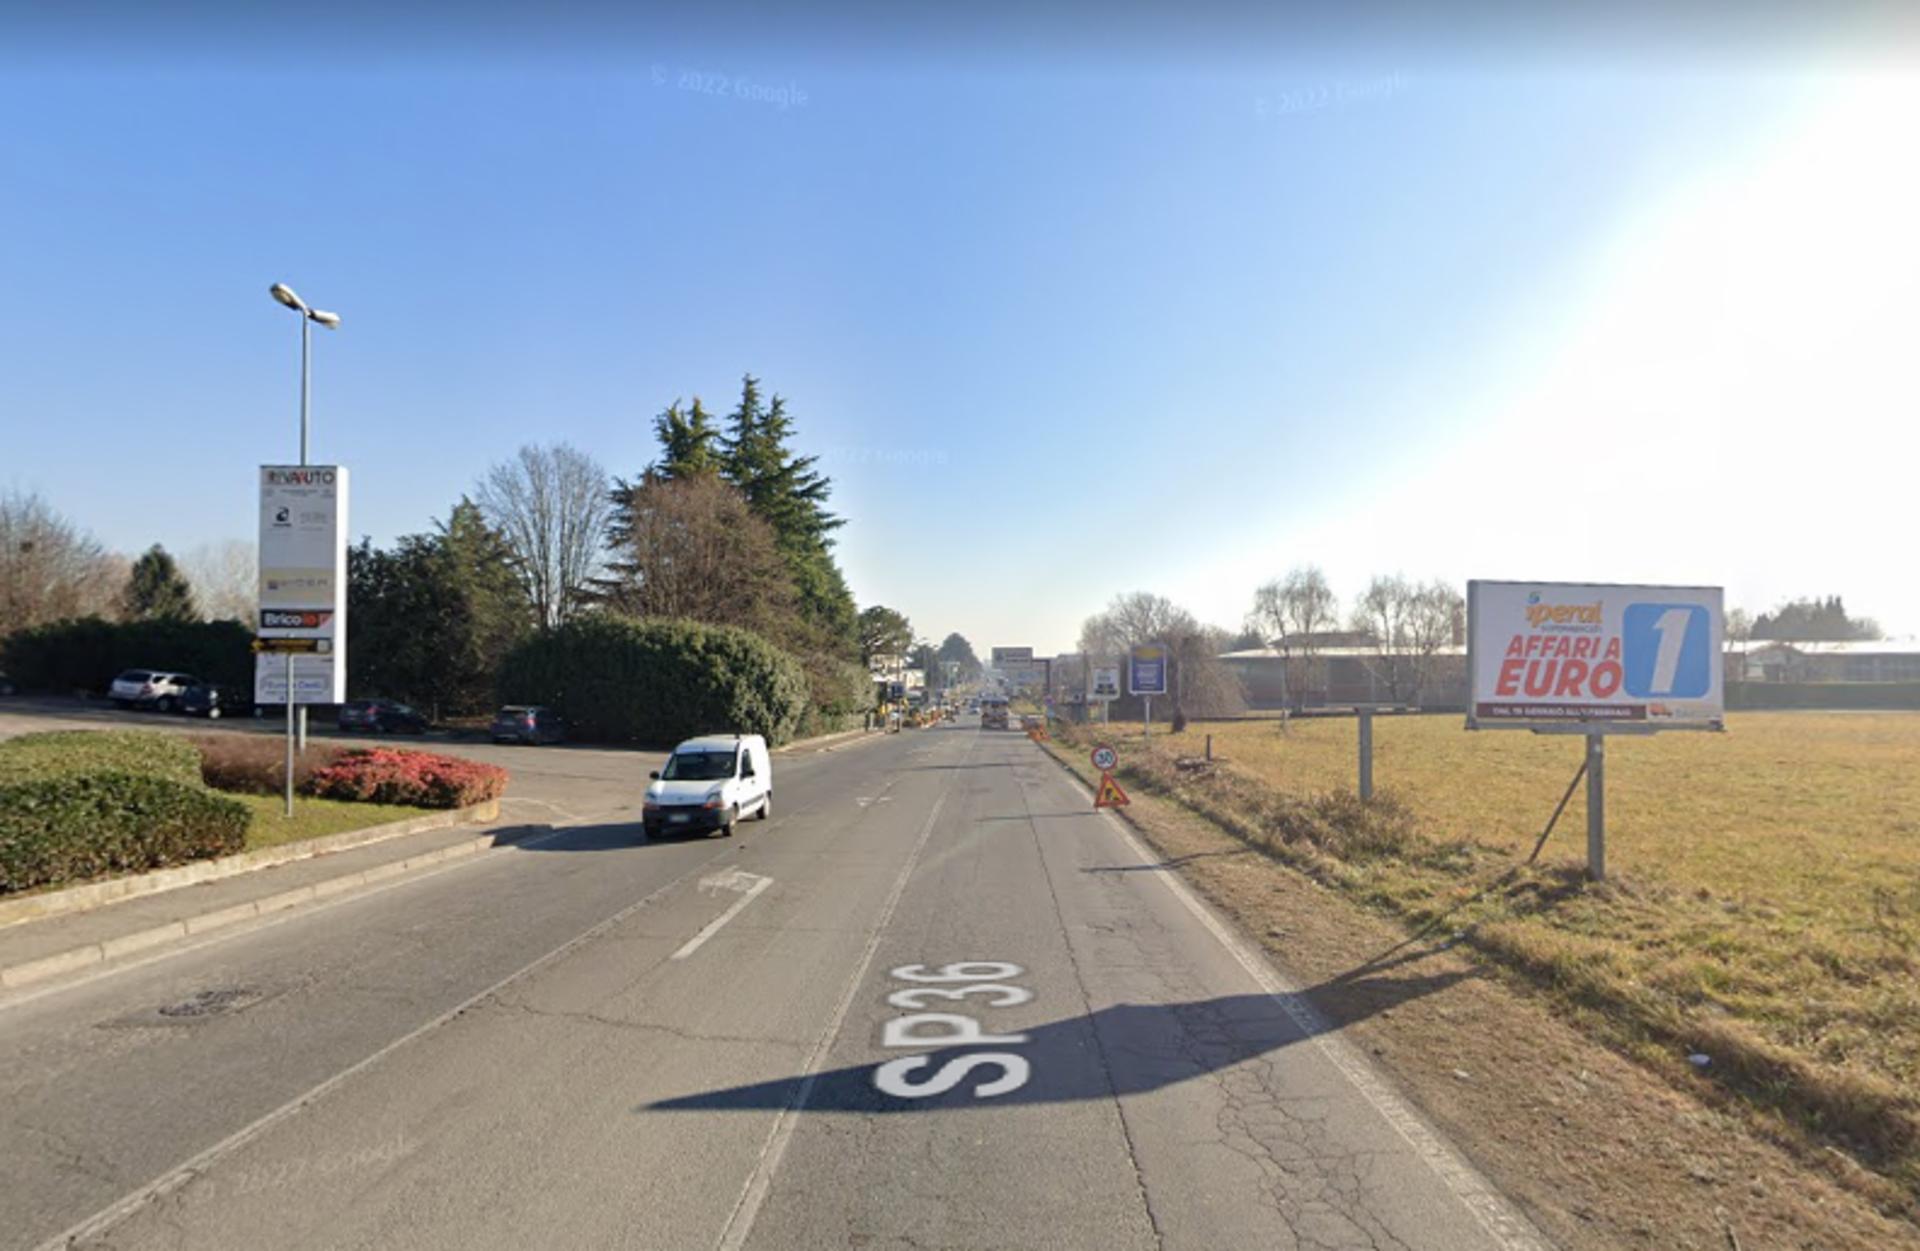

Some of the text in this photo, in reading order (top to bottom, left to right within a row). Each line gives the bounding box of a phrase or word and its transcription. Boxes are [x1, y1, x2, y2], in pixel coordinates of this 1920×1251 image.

[1506, 634, 1620, 659] AFFARI A
[1650, 608, 1693, 693] 1
[1495, 658, 1624, 698] EURO
[874, 960, 1034, 1098] SP36
